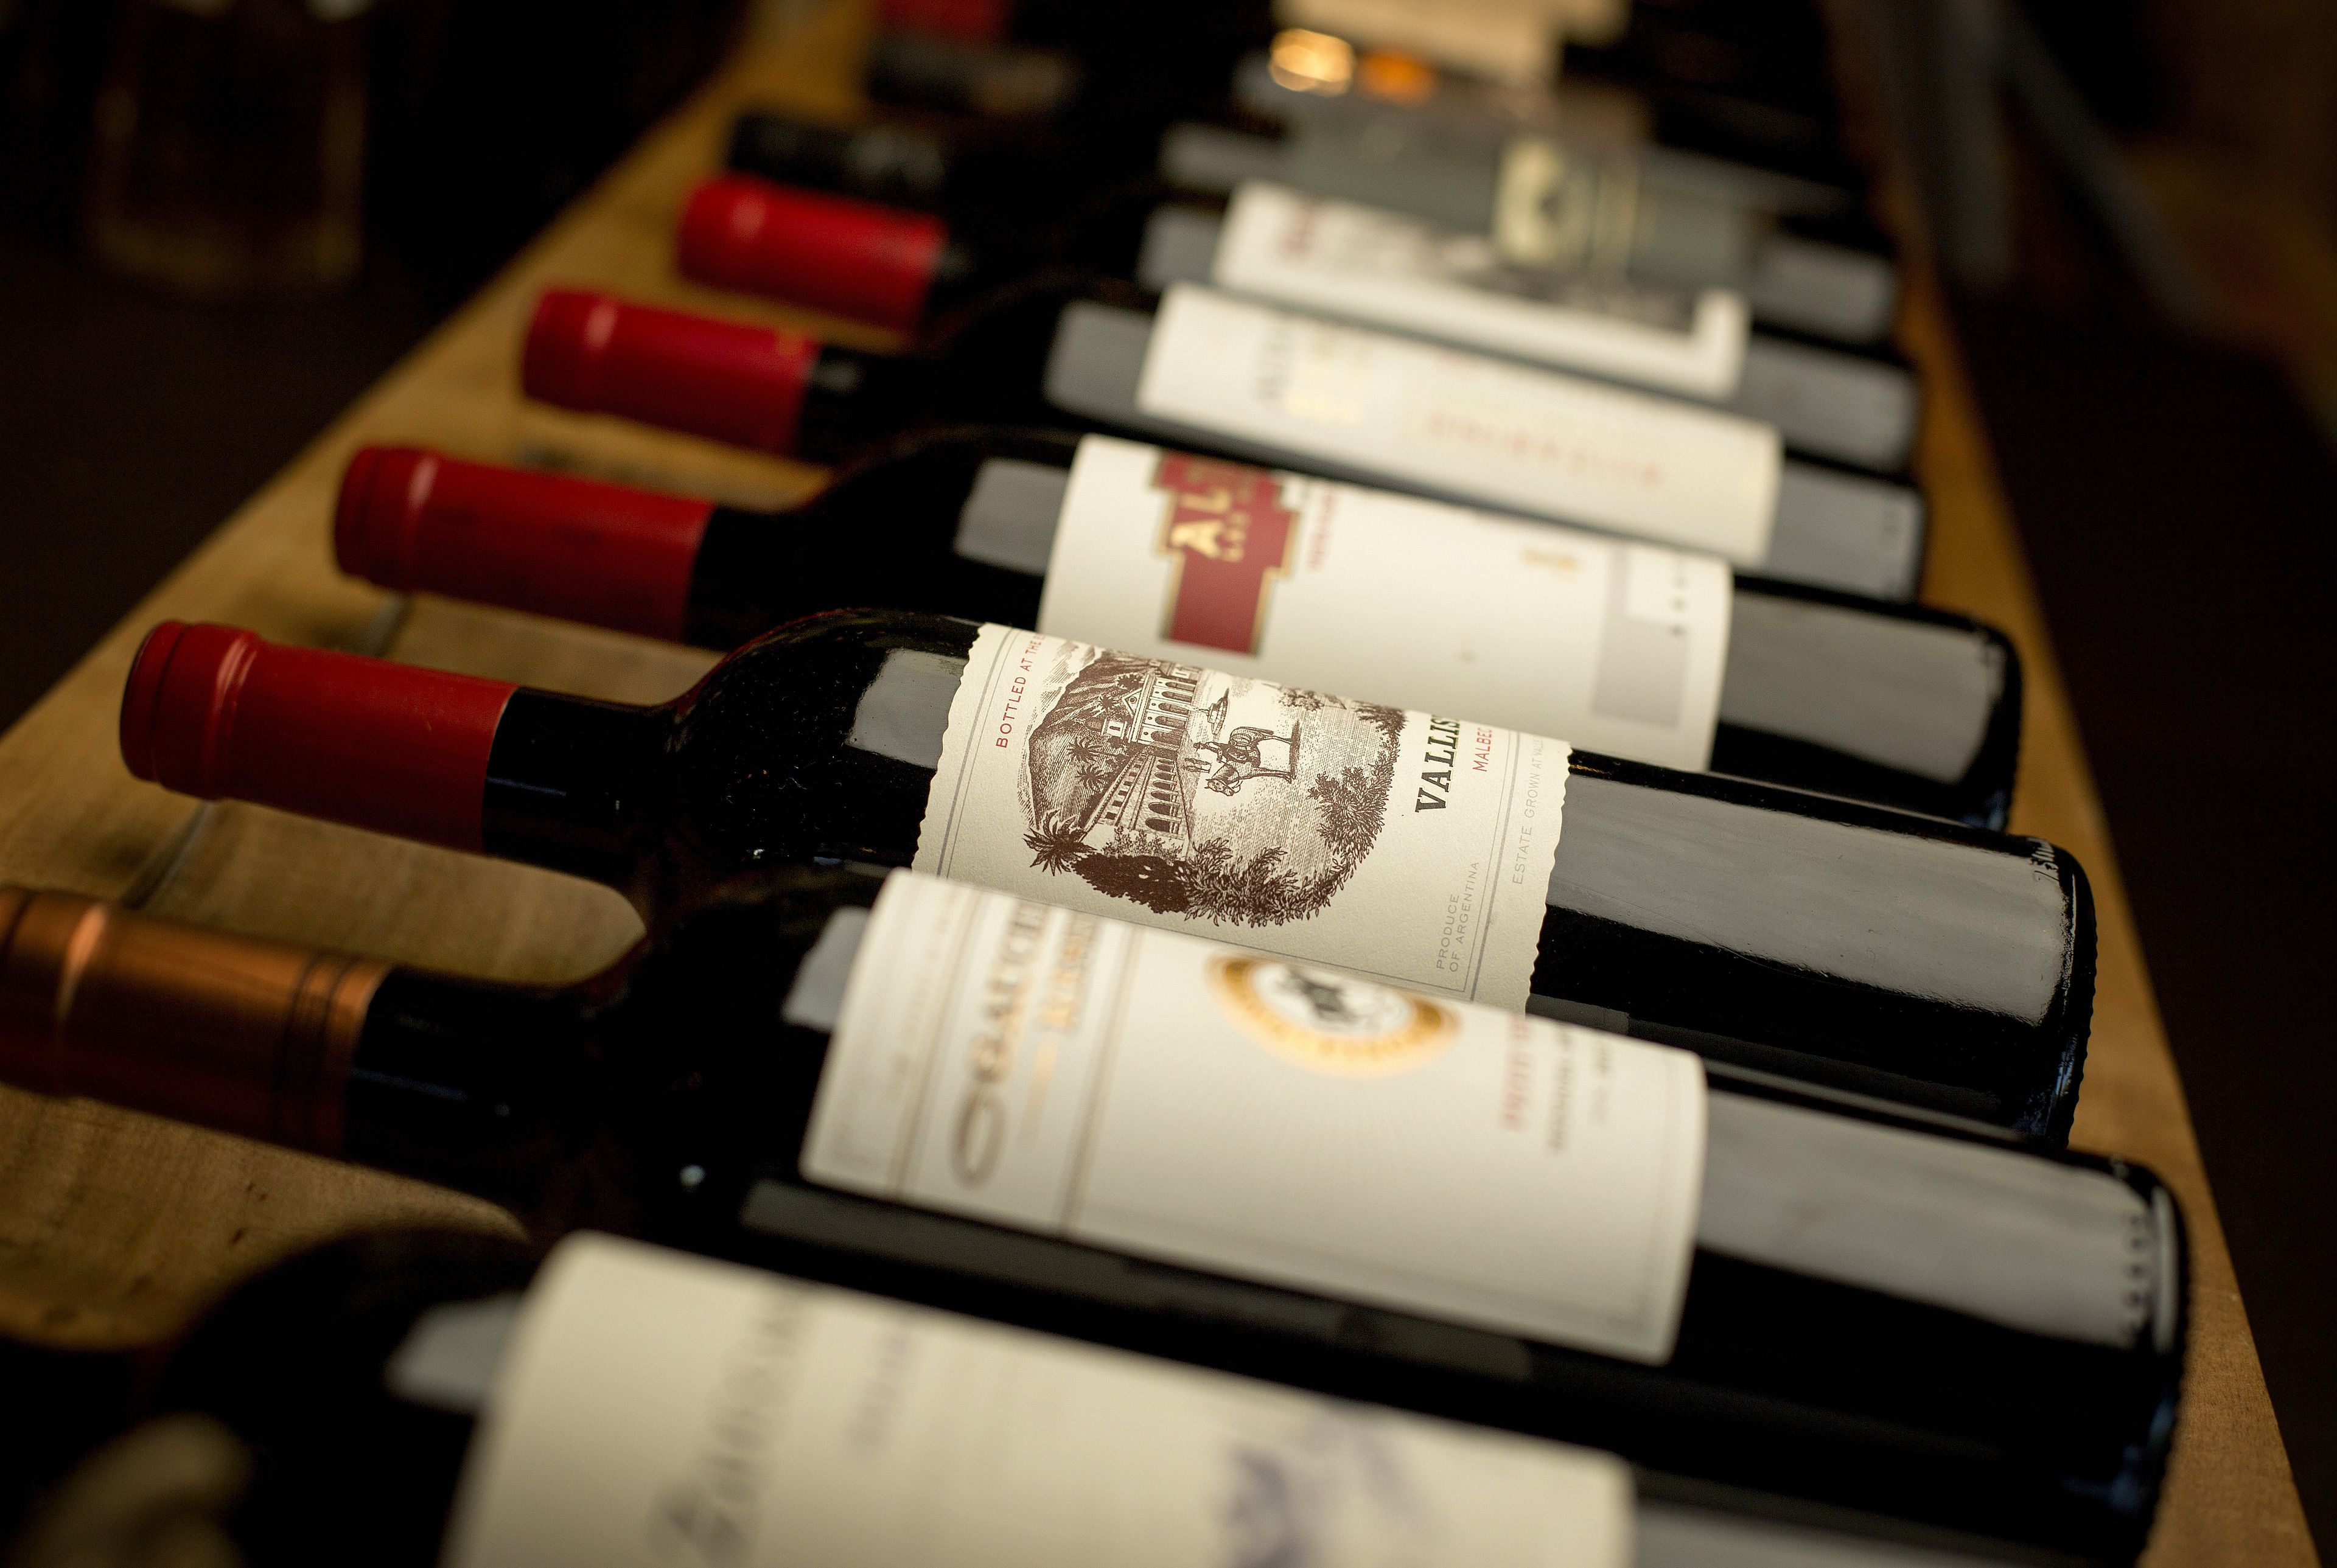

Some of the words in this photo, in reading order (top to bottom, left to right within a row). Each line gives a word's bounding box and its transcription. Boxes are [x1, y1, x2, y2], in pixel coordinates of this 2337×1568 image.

[1019, 658, 1033, 672] AT
[1025, 640, 1041, 655] THE
[996, 677, 1026, 748] BOTTLED
[1414, 716, 1460, 813] VALLIS
[1512, 826, 1532, 885] ESTATE
[1524, 773, 1540, 818] GROWN
[1532, 758, 1542, 770] AT
[1436, 894, 1459, 969] PRODUCE
[1449, 951, 1460, 972] OF
[1456, 862, 1479, 944] ARGENTINA
